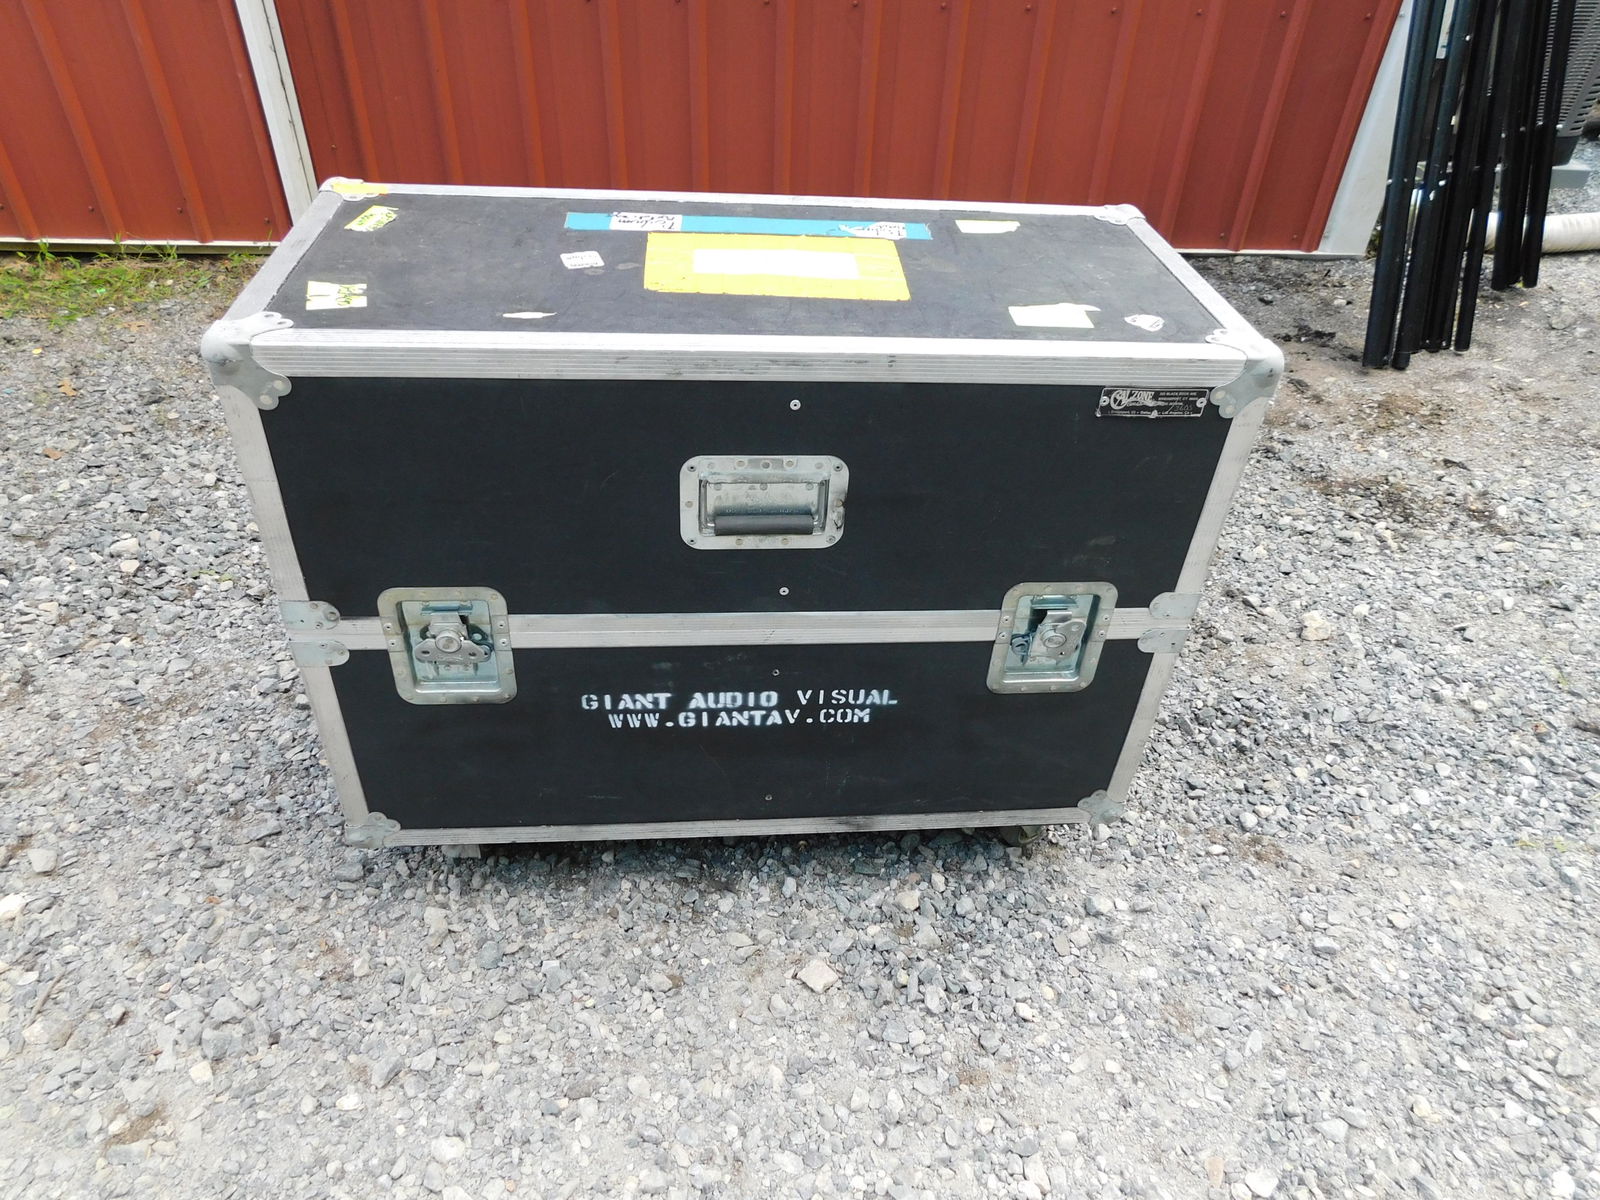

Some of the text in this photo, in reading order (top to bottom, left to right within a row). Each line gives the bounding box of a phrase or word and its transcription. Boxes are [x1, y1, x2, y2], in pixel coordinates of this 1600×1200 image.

[580, 688, 899, 711] GIANT AUDIO VISUAL
[607, 707, 872, 730] WWW.GIANTAV.COM
